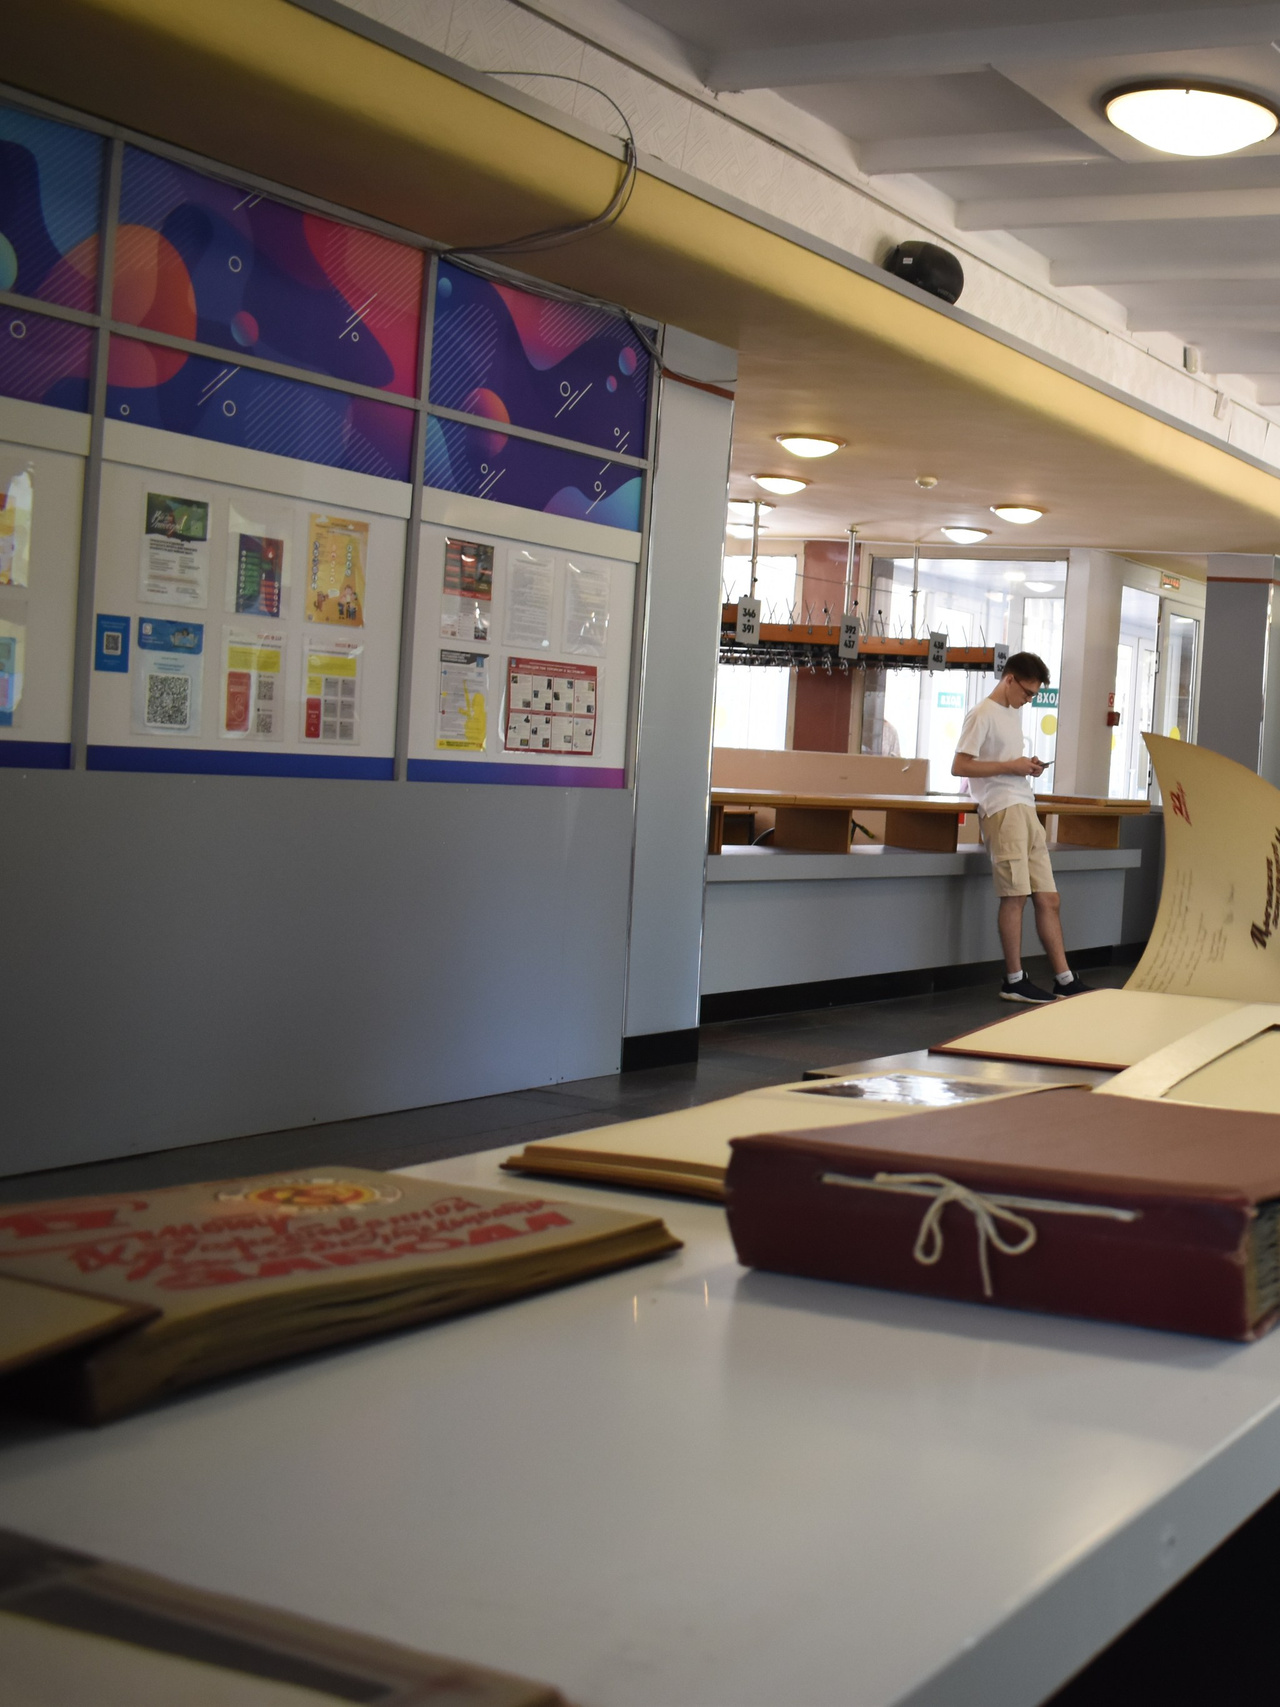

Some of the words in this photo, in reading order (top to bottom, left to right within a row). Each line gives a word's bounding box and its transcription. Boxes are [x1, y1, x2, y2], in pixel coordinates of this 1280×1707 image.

[742, 607, 756, 619] 346
[742, 624, 754, 634] 391
[845, 624, 857, 635] 392
[844, 640, 855, 649] 437
[933, 641, 945, 650] 438
[932, 653, 943, 663] 483
[940, 694, 962, 706] ВХОД
